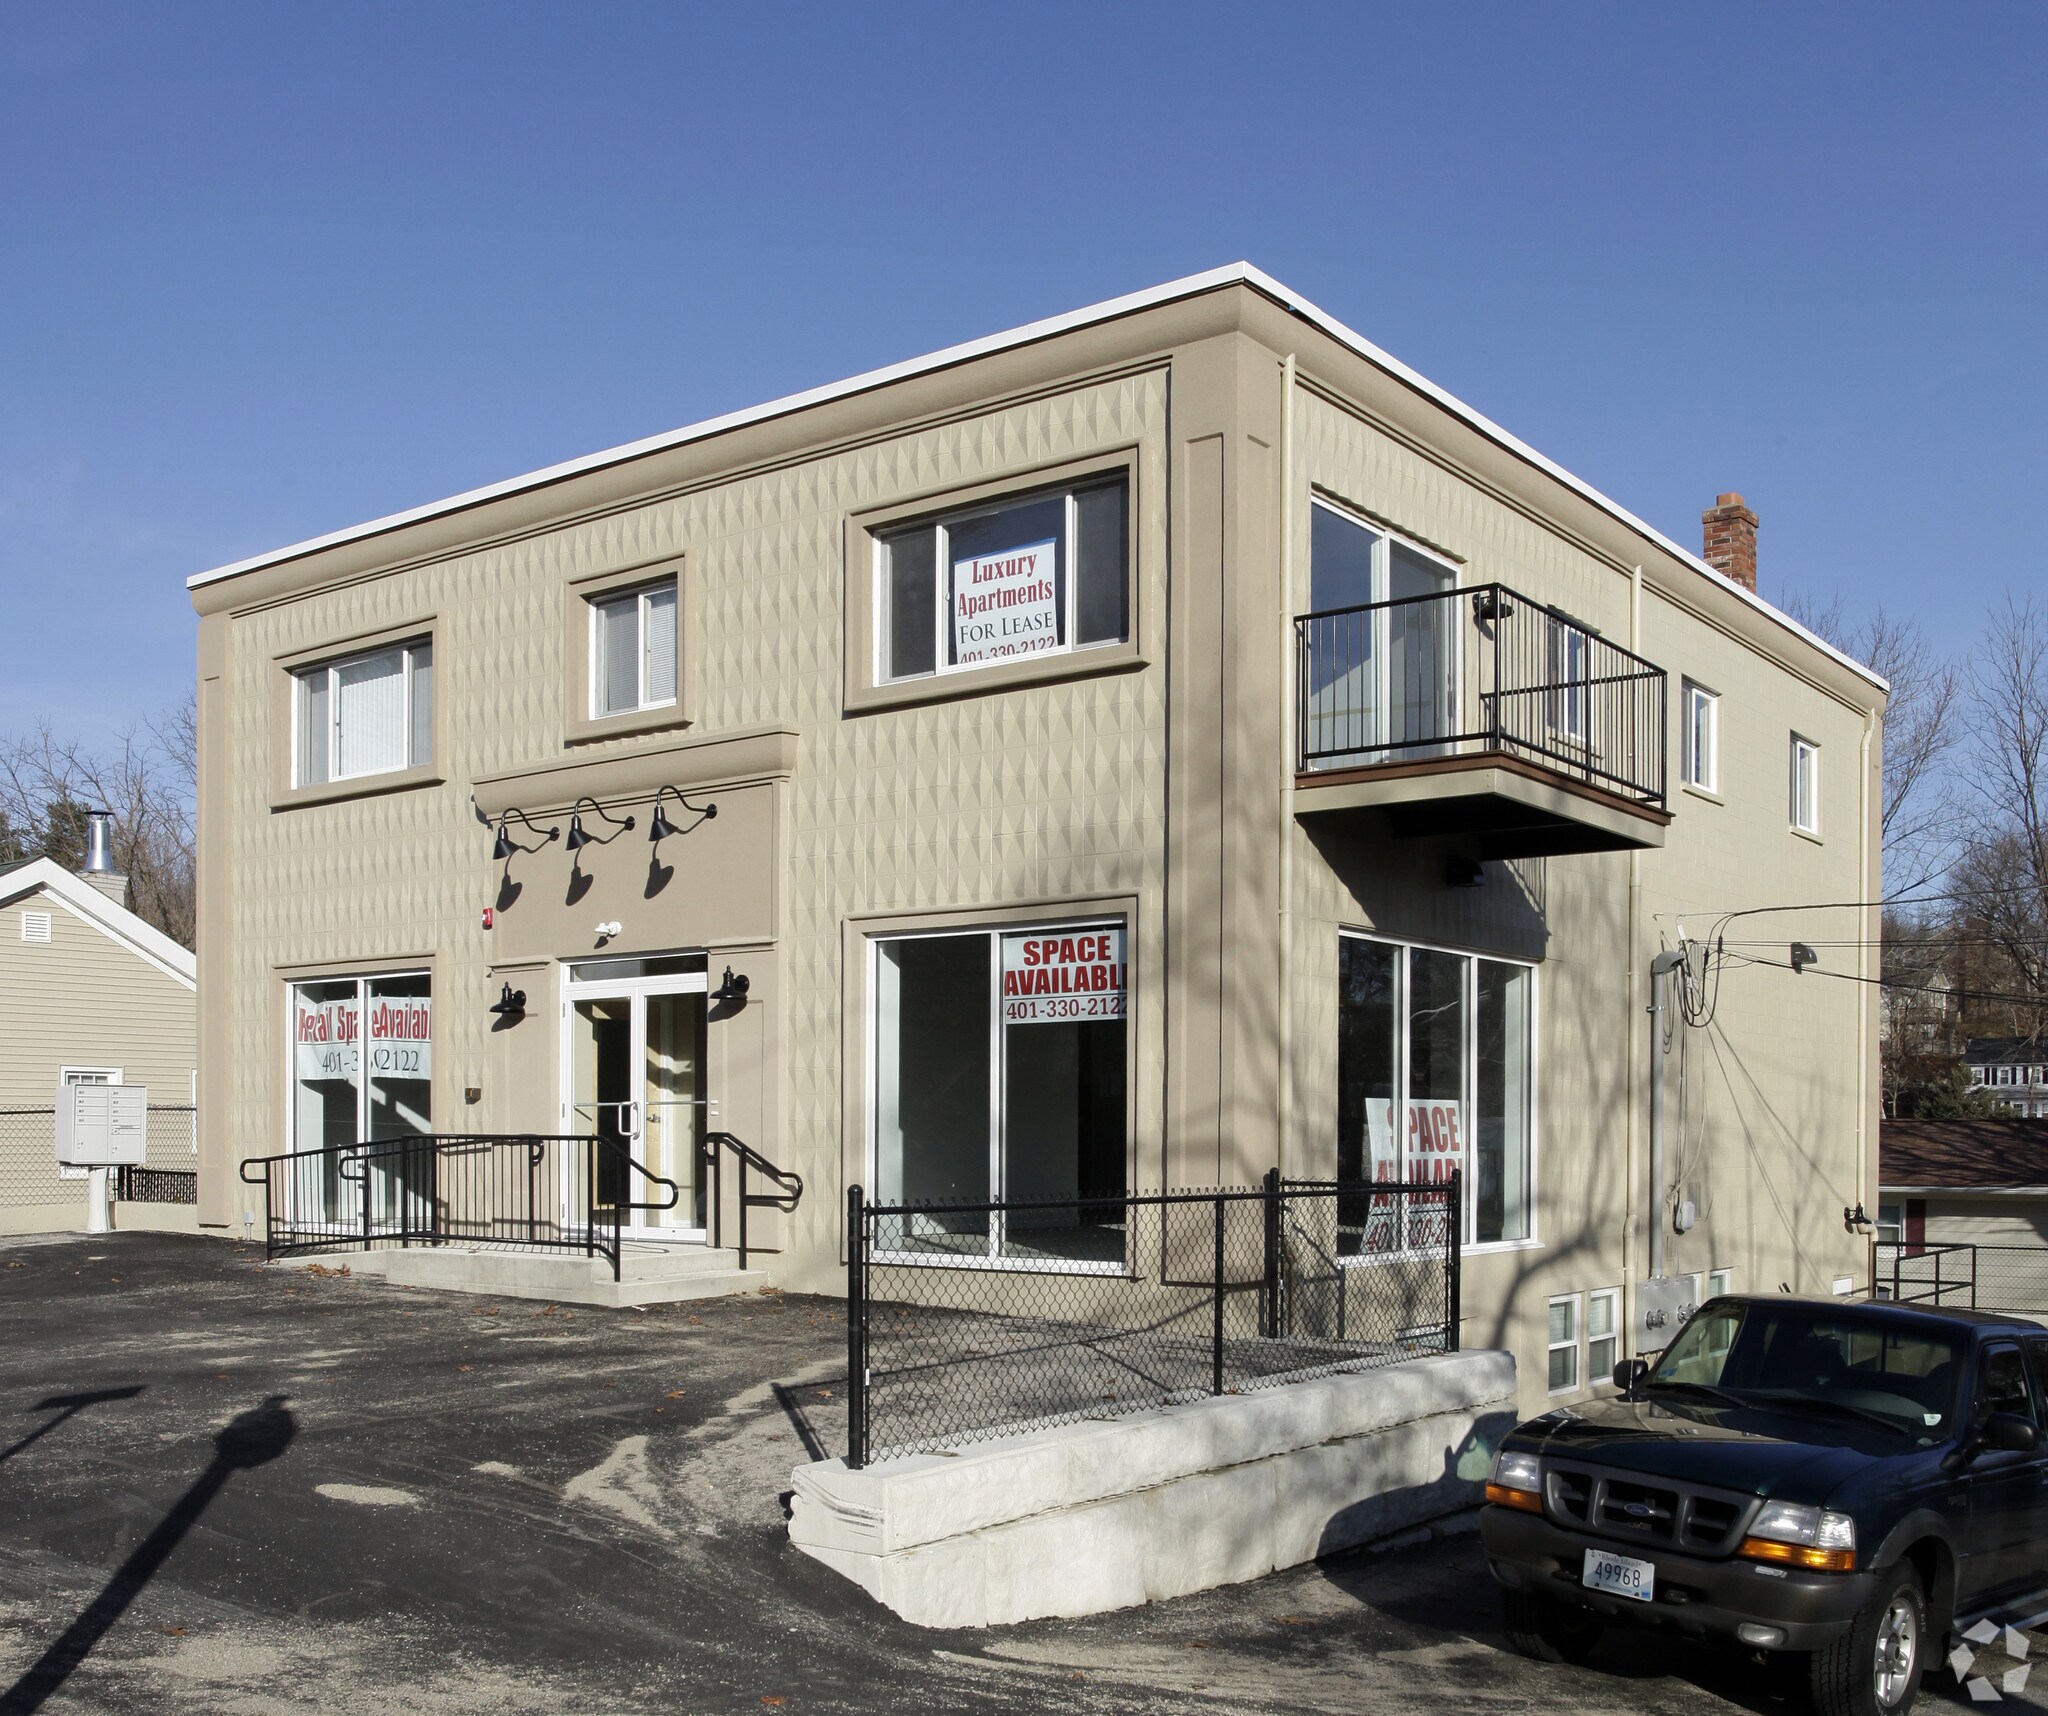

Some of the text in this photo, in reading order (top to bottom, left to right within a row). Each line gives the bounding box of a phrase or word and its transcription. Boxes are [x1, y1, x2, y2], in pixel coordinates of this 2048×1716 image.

[972, 554, 1037, 584] Luxury
[957, 579, 1053, 619] Apartments
[960, 611, 1054, 644] FOR LEASE
[1023, 935, 1112, 966] SPACE
[337, 1005, 380, 1046] Spae
[378, 1002, 432, 1039] Availab
[1595, 1561, 1641, 1588] 49968
